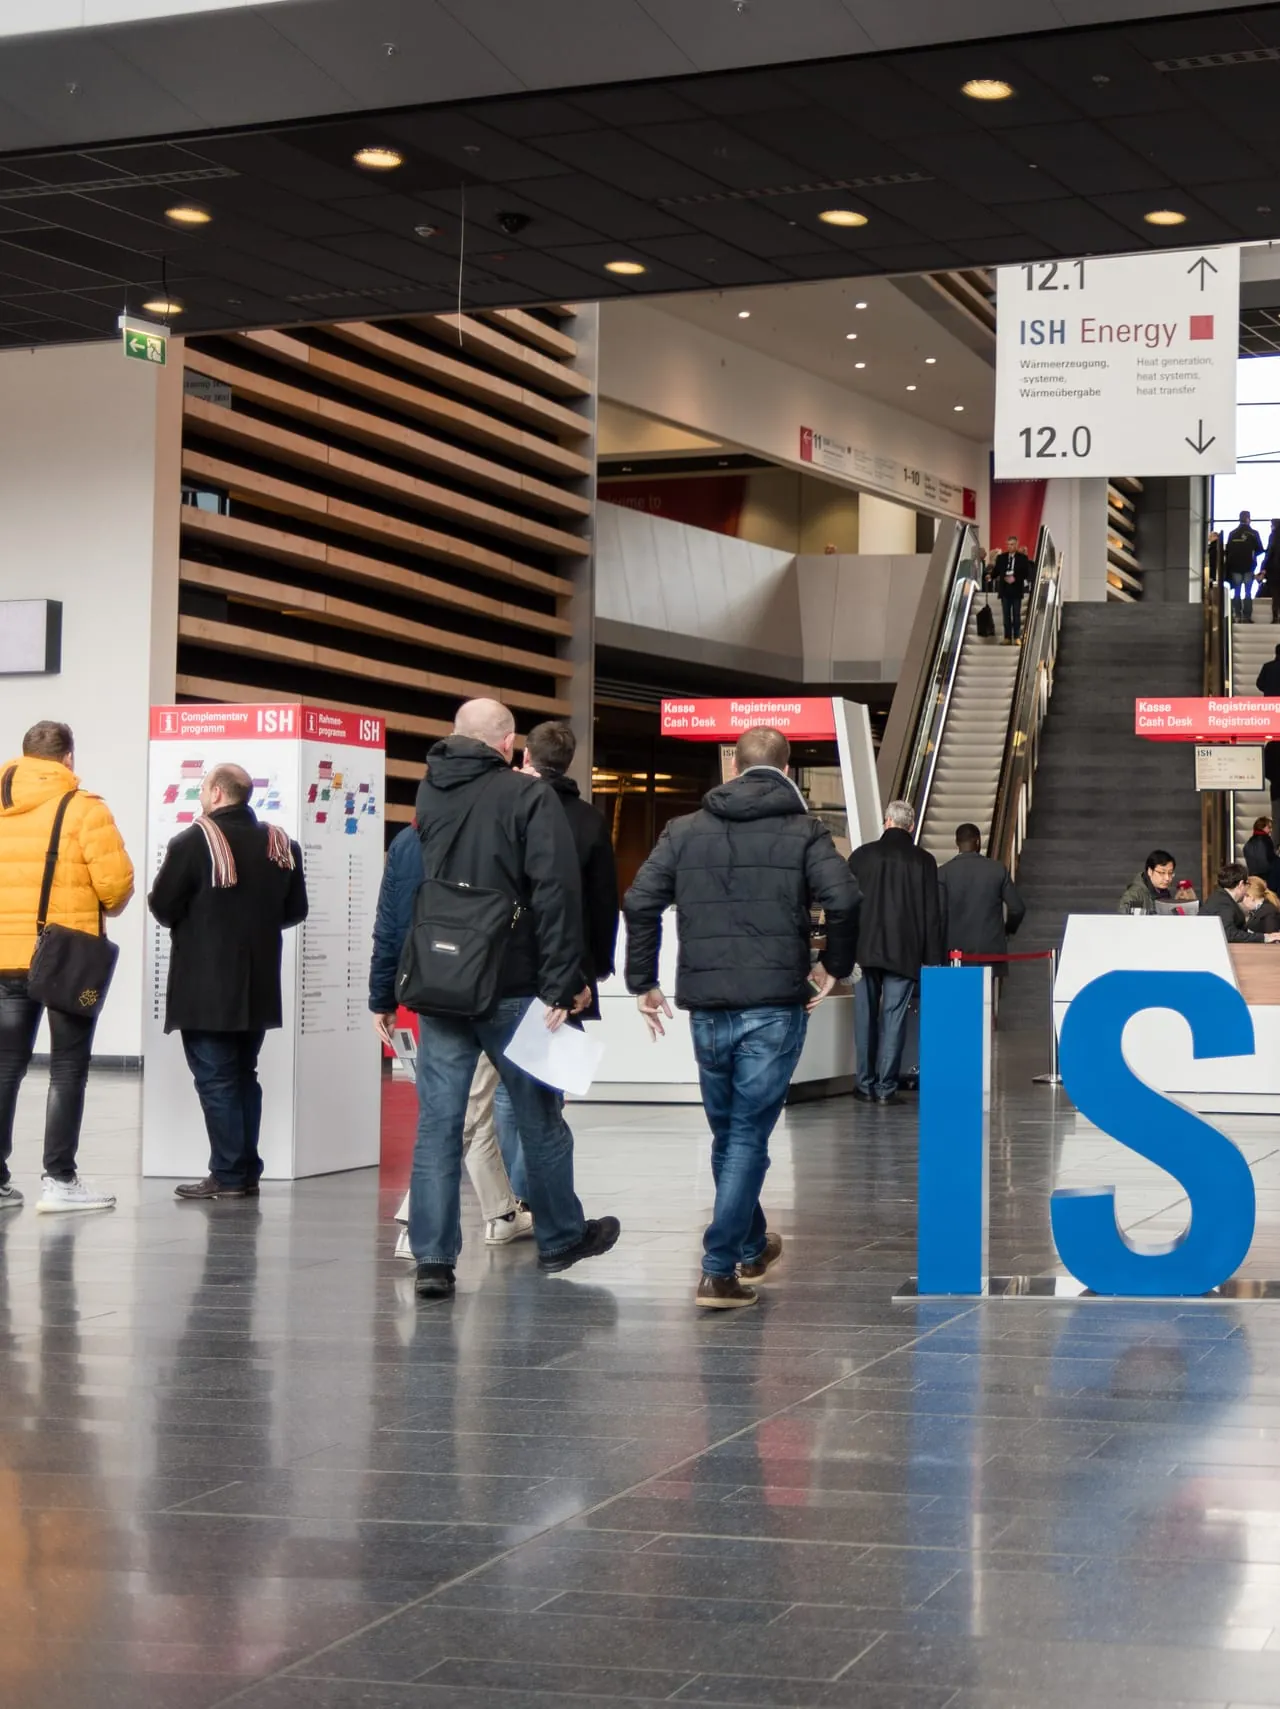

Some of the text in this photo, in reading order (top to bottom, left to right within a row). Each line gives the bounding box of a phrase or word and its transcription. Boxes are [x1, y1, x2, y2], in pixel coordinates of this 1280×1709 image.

[1021, 260, 1086, 291] 12.1
[1020, 318, 1177, 348] ISH Energy
[1020, 358, 1110, 370] Wärmeerzeugung,
[1136, 356, 1214, 368] Heat generation,
[1136, 372, 1157, 381] heat
[1020, 387, 1101, 398] Wärmeübergabe
[1136, 385, 1196, 396] heat transfer
[1019, 425, 1092, 458] 12.0
[664, 702, 695, 713] Kasse
[730, 702, 801, 715] Registrierung
[1139, 701, 1171, 712] Kasse
[181, 711, 248, 724] Complementary
[257, 709, 294, 733] ISH
[318, 713, 343, 725] Rahmen-
[664, 717, 716, 728] Cash Desk
[730, 716, 789, 729] Registration
[1139, 716, 1193, 727] Cash Desk
[1208, 715, 1270, 729] Registration
[181, 723, 225, 736] programm
[318, 727, 347, 739] programm
[359, 719, 380, 742] ISH
[1197, 749, 1212, 757] ISH
